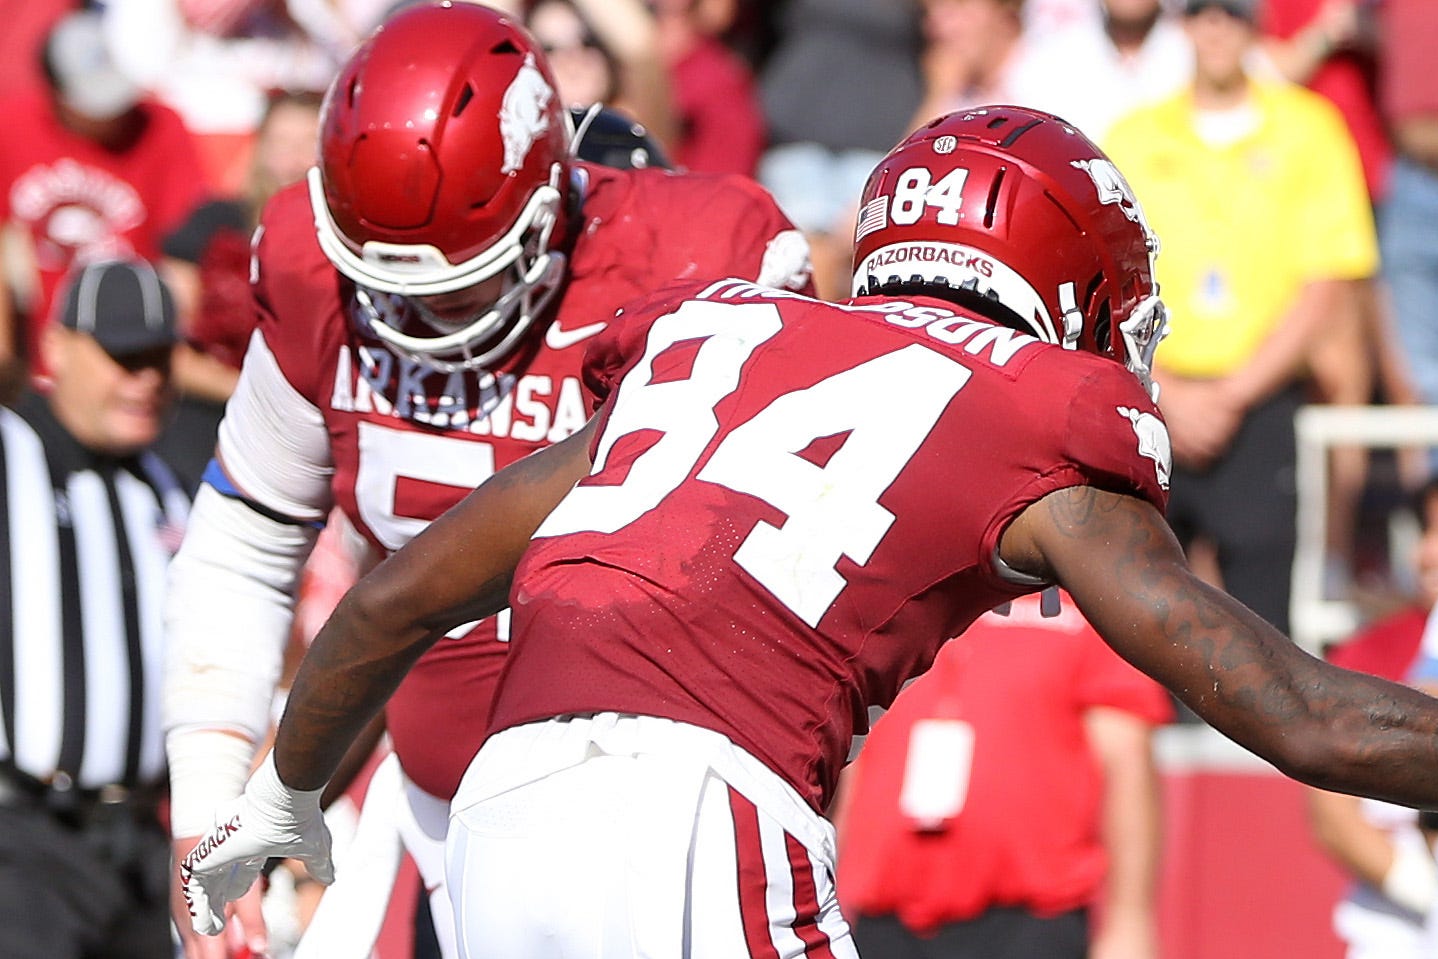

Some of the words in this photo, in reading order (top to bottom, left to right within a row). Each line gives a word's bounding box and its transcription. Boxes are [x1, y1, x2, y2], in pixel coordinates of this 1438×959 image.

[890, 166, 970, 226] 84
[867, 247, 994, 278] RAZORBACKS
[331, 345, 590, 444] ARKANSA
[531, 299, 972, 628] 84
